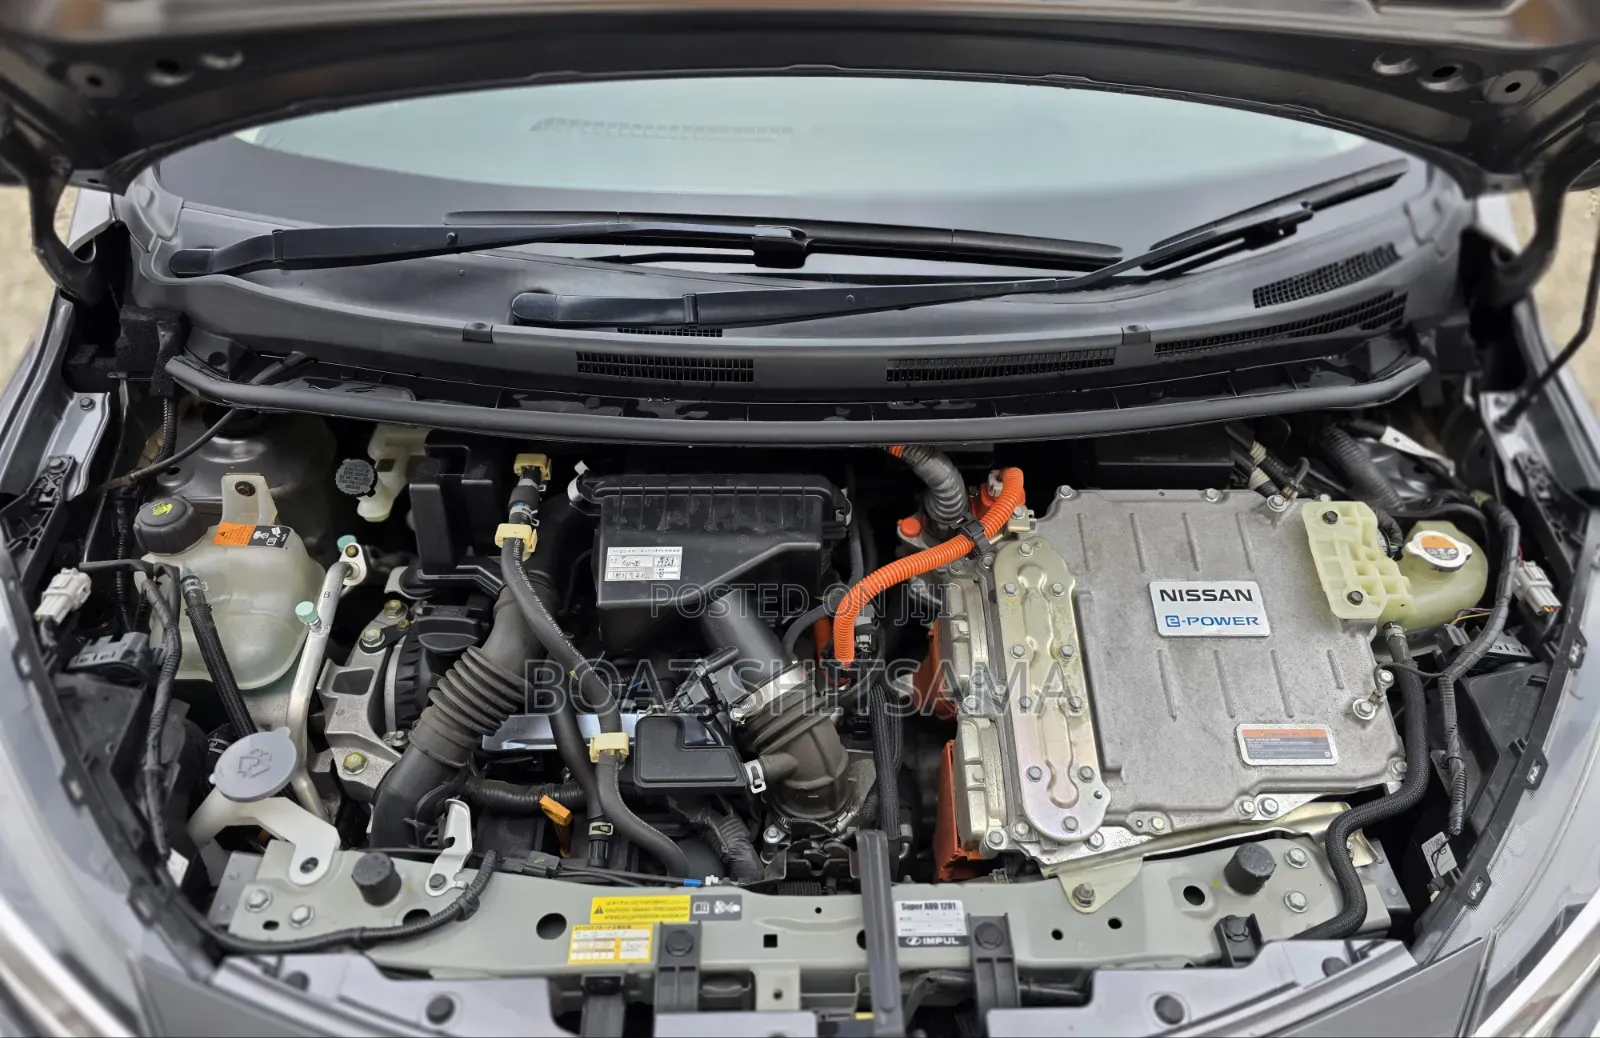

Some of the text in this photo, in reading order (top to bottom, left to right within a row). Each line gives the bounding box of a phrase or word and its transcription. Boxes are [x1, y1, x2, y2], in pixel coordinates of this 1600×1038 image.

[1159, 589, 1254, 602] NISSAN
[900, 902, 923, 911] Super
[922, 936, 960, 945] IMPUL
